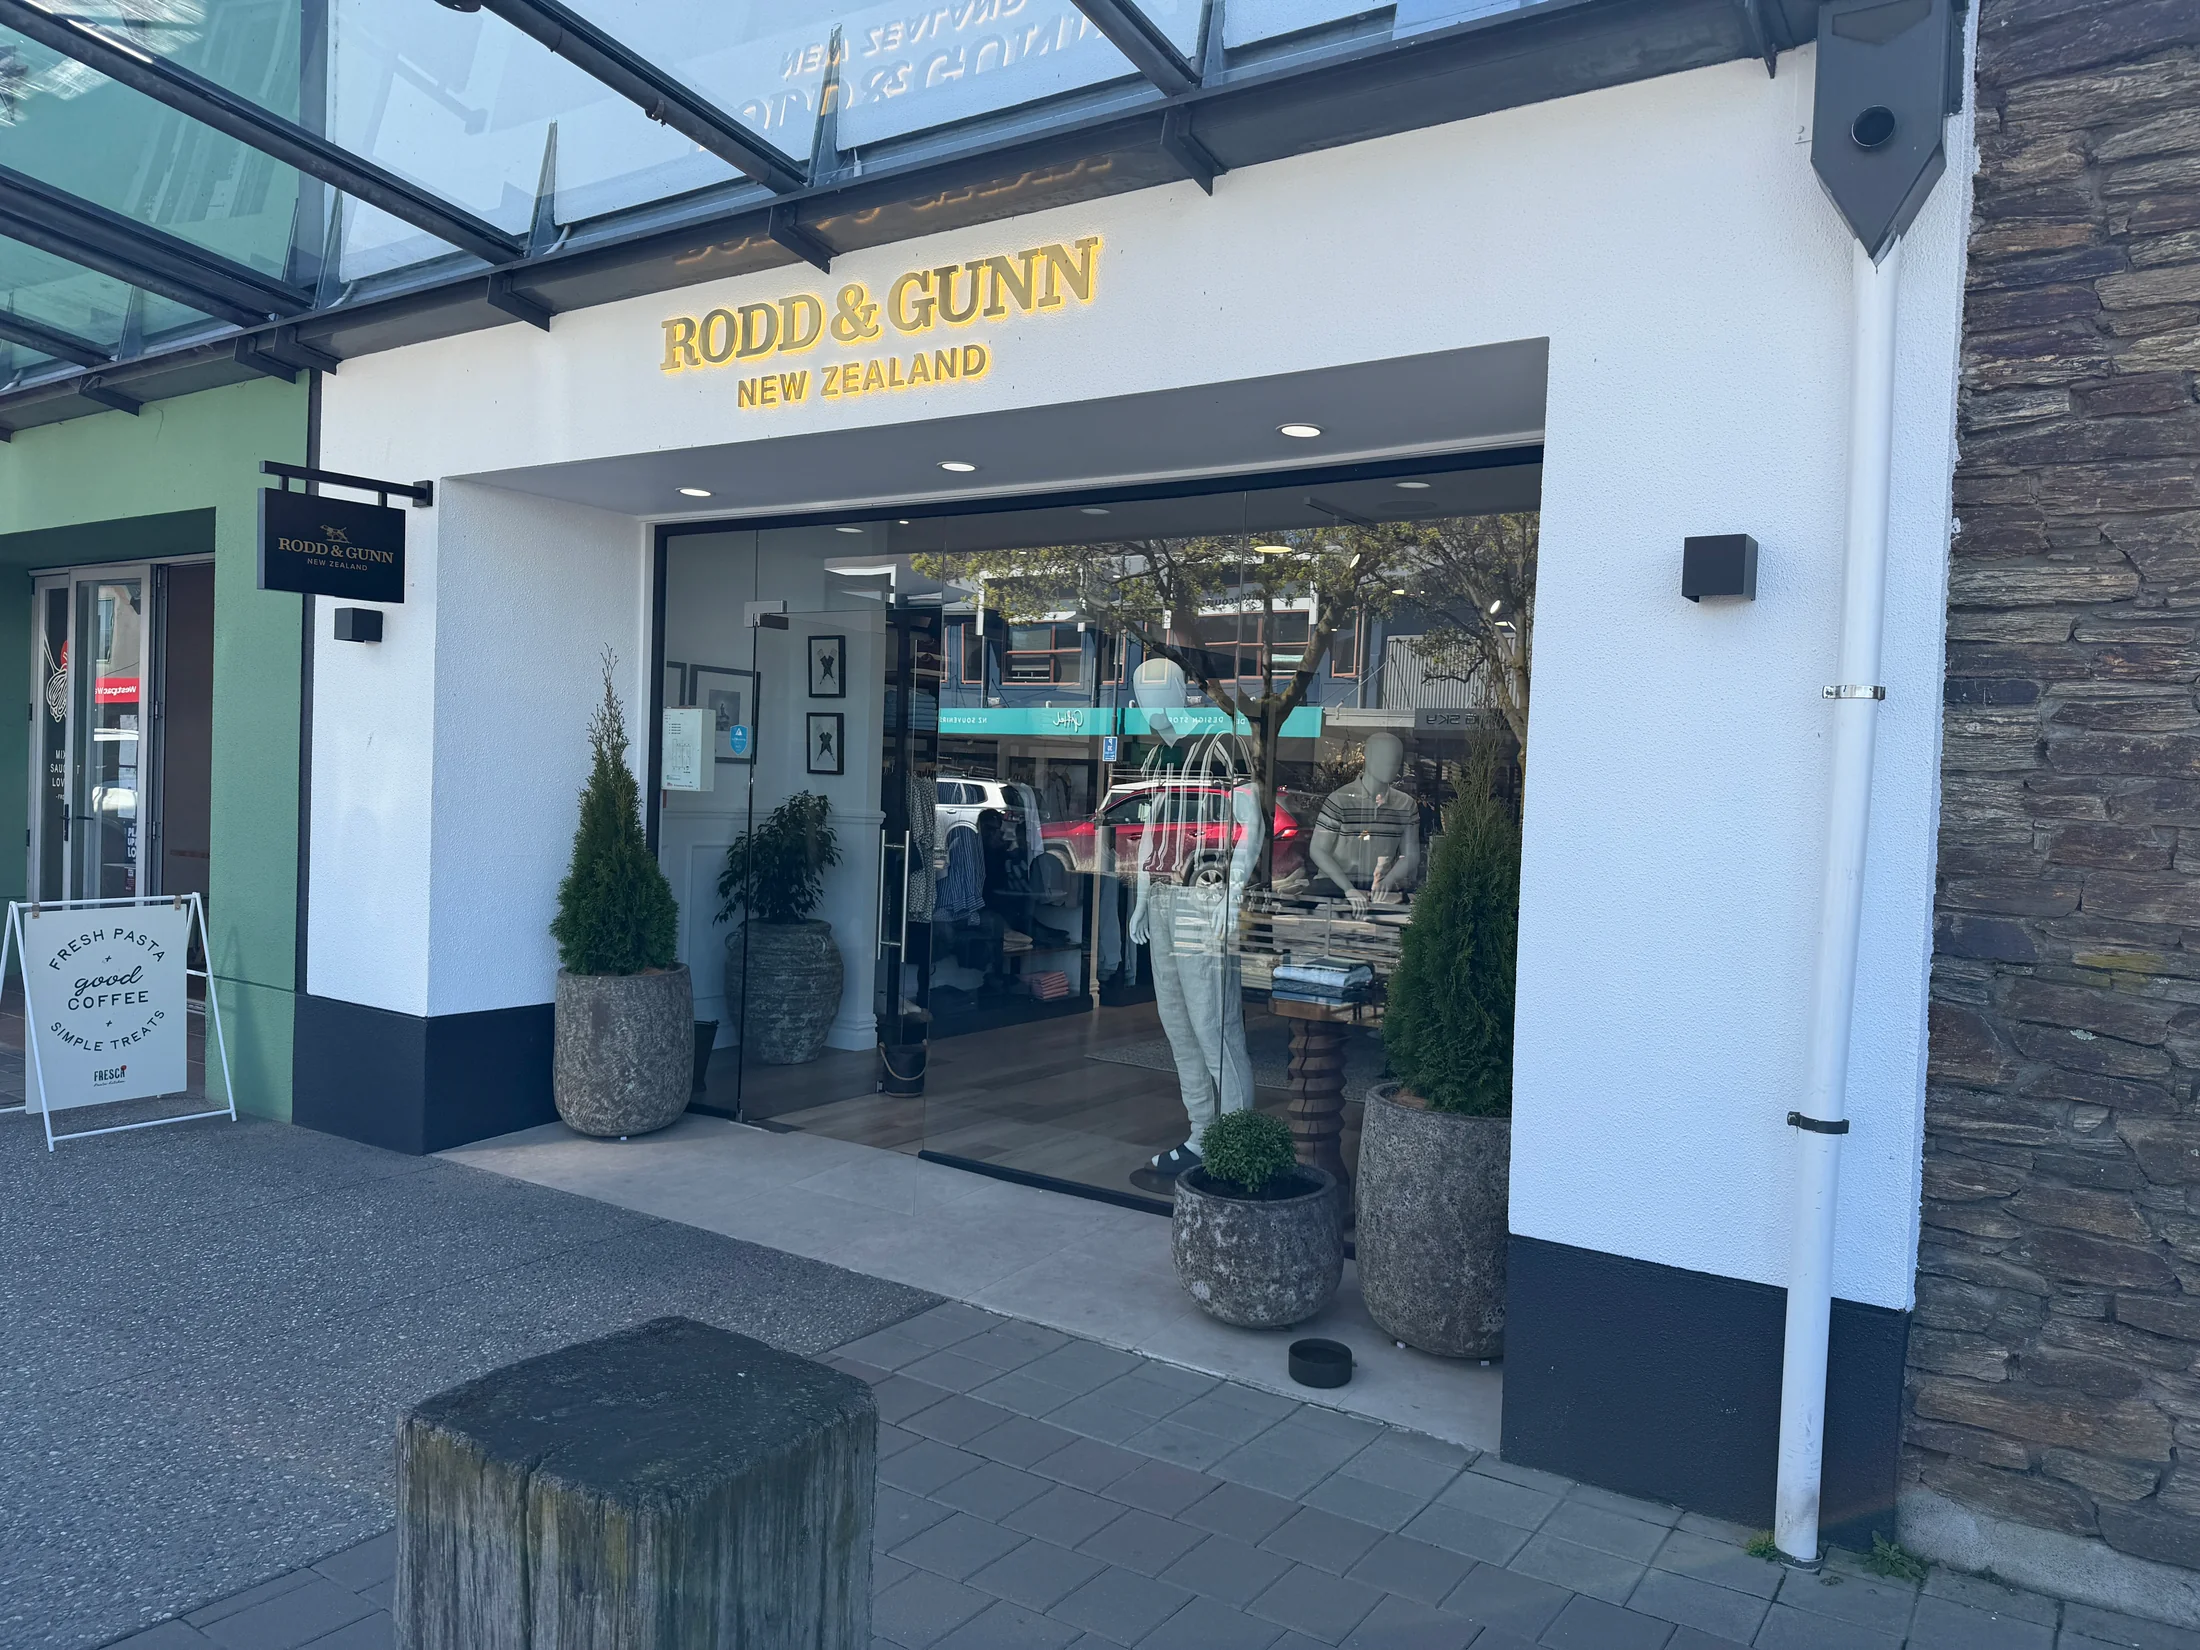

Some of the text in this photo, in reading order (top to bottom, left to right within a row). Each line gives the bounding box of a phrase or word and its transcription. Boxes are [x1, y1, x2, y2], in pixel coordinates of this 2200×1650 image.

[659, 236, 1098, 371] RODD & GUNN
[737, 344, 986, 408] NEW ZEALAND
[278, 537, 394, 564] RODD & GUNN
[307, 558, 368, 571] NEW ZEALAND
[48, 928, 165, 970] FRESH PASTA
[74, 965, 144, 997] good
[68, 990, 149, 1010] COFFEE
[50, 1010, 165, 1051] SIMPLE TREATS
